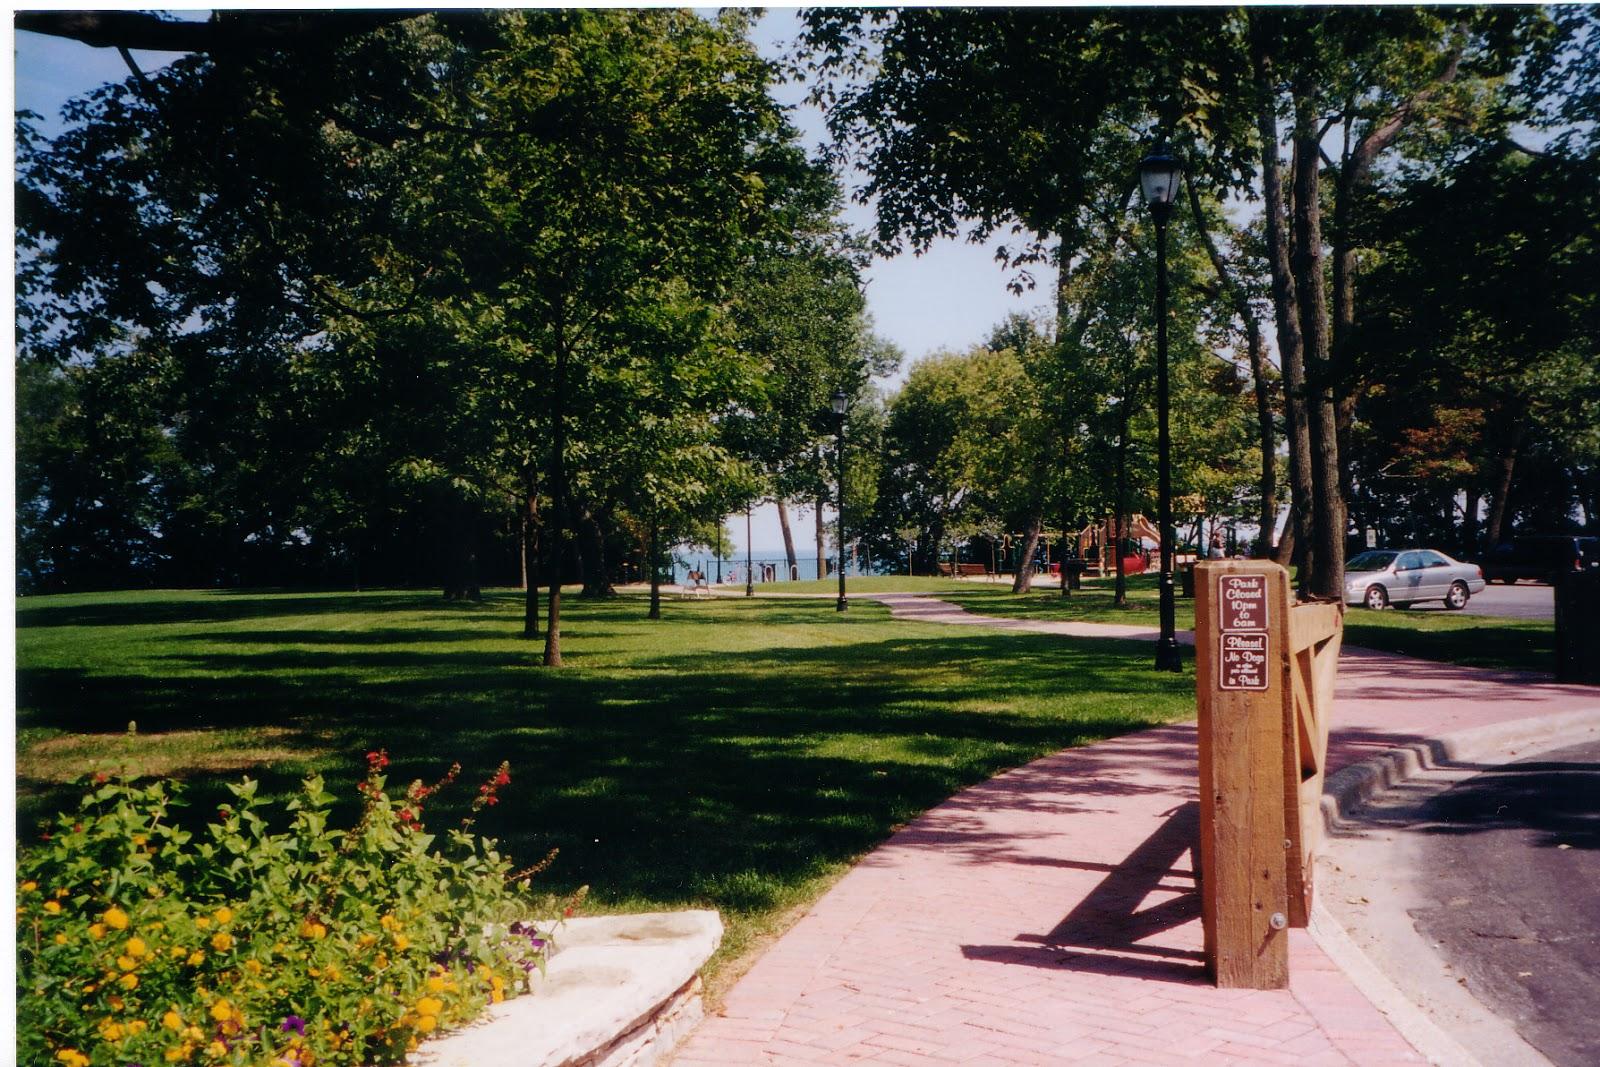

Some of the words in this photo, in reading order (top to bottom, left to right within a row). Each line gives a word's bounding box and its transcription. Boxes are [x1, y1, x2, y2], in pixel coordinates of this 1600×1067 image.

[1229, 578, 1259, 588] Park
[1226, 588, 1262, 600] Closed
[1231, 600, 1257, 611] 10pm
[1239, 611, 1250, 619] to
[1233, 618, 1256, 627] 6am
[1225, 651, 1240, 662] No
[1242, 651, 1264, 665] Dogs
[1238, 675, 1260, 686] Park
